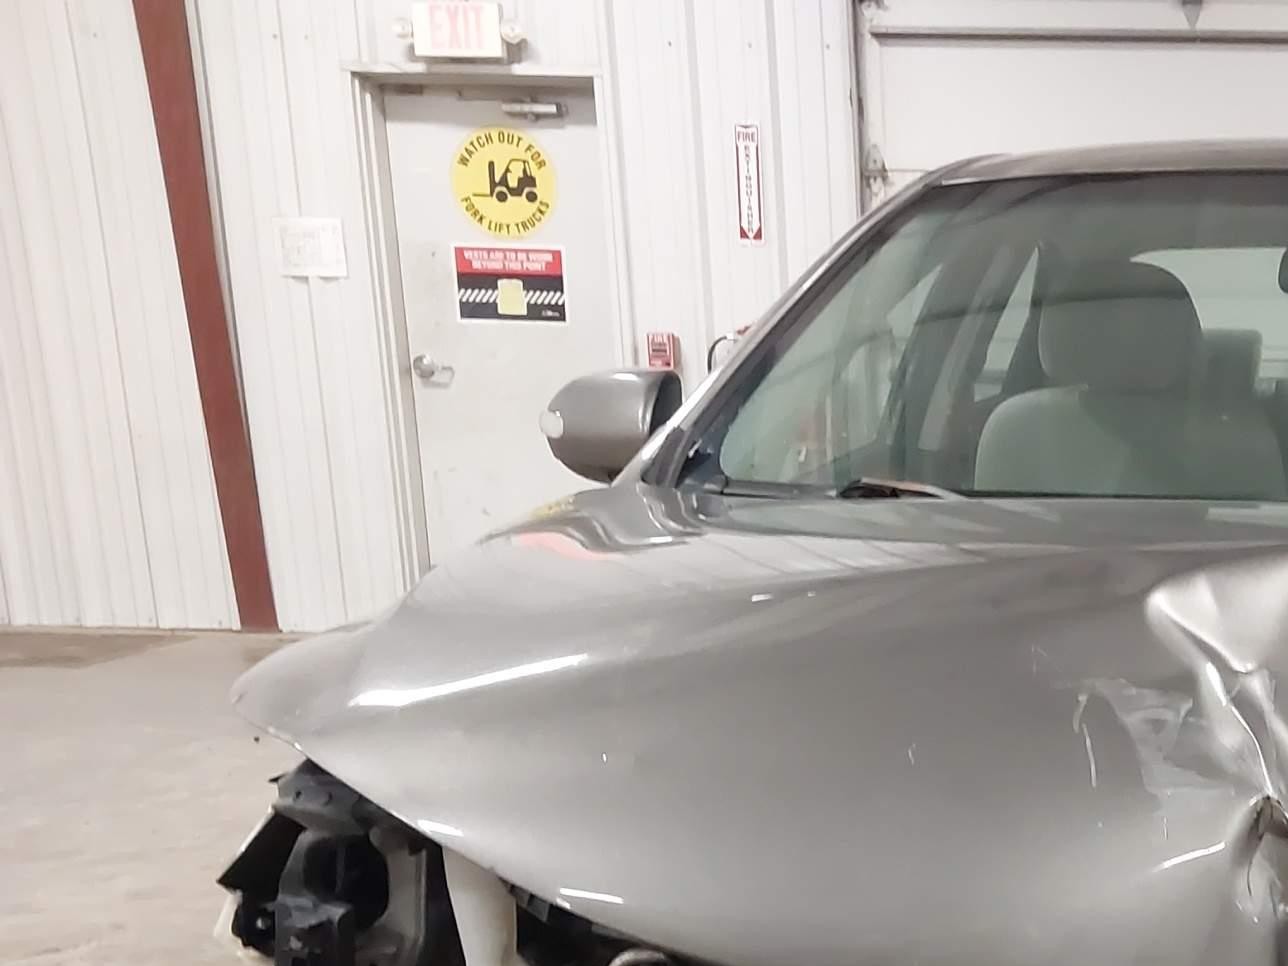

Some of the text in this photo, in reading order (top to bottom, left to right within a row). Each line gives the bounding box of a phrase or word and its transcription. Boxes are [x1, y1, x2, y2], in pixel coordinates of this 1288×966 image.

[429, 3, 484, 49] EXIT
[457, 130, 547, 170] WATCH OUT FOR
[737, 131, 756, 142] FIRE
[461, 195, 550, 235] FORK LIFT TRUCKS
